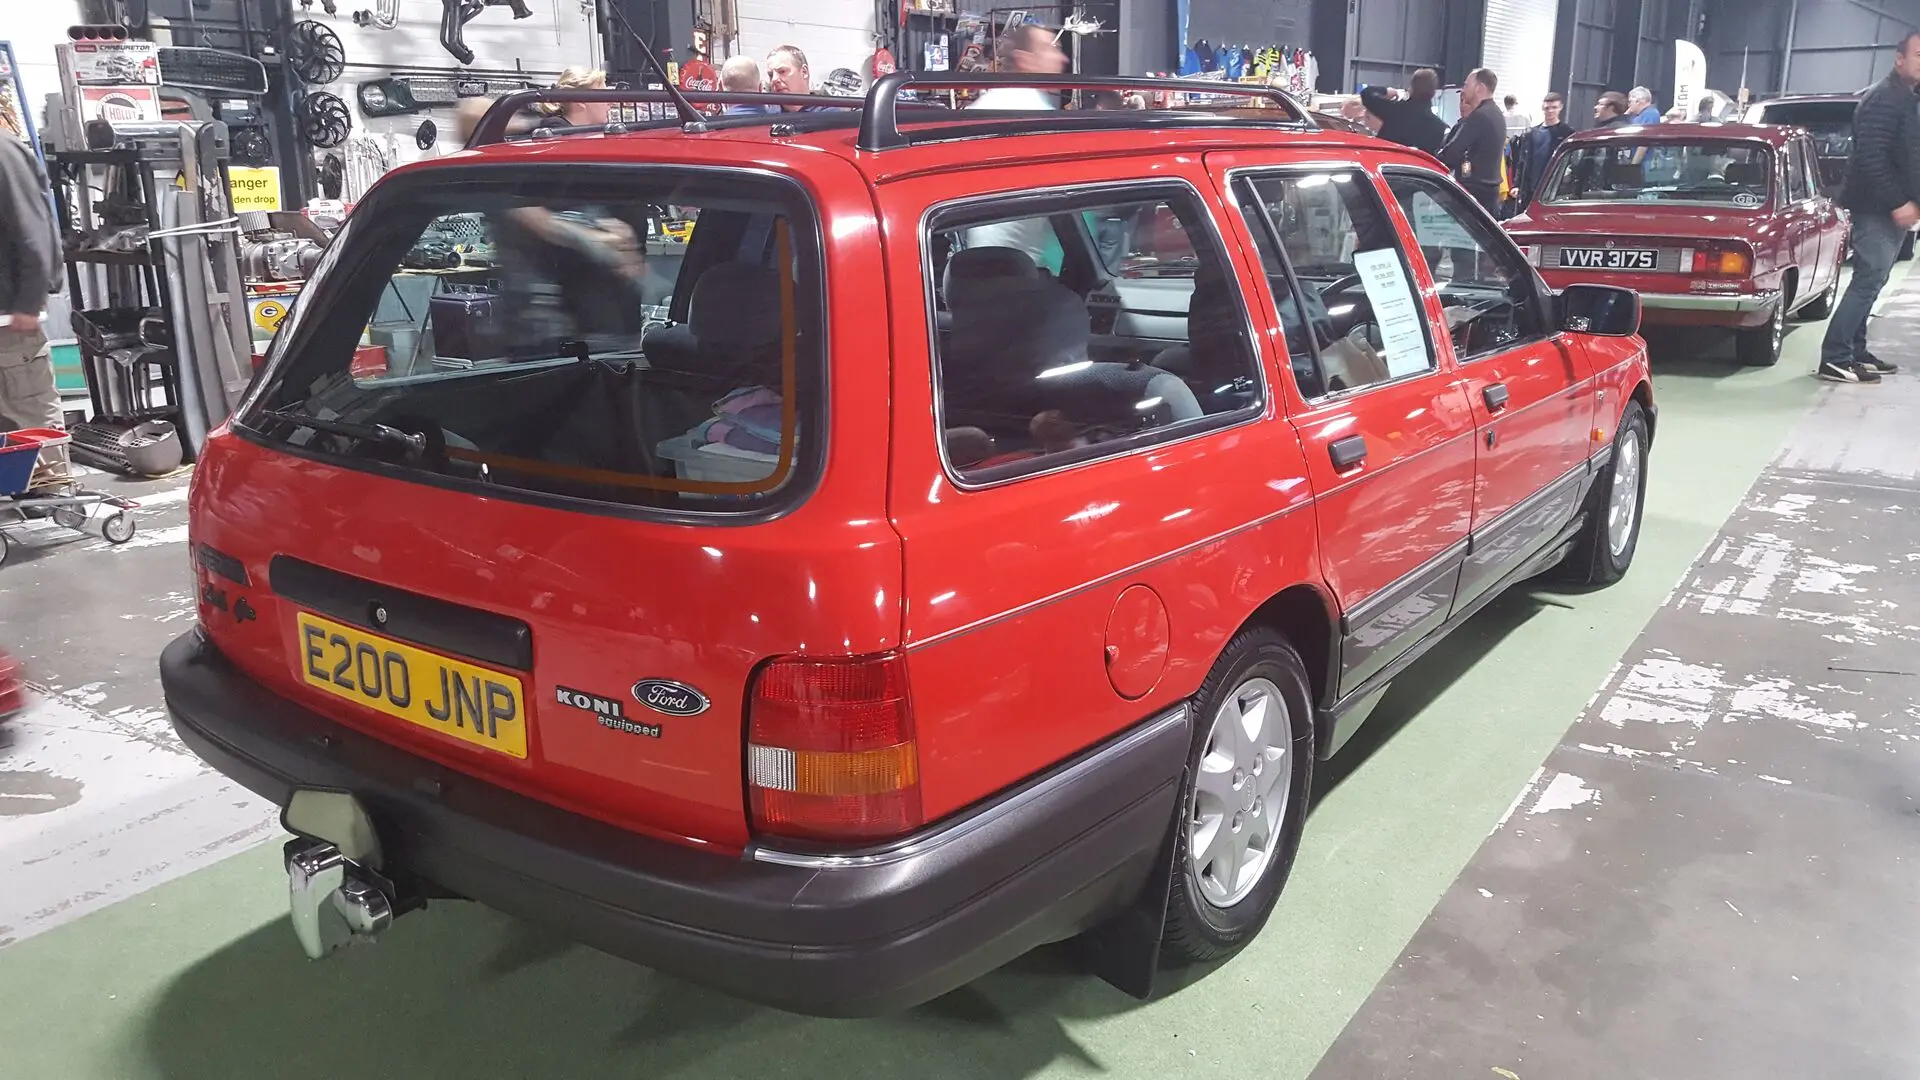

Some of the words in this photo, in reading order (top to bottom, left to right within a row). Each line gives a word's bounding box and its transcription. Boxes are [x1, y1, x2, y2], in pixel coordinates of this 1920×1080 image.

[230, 179, 268, 190] anger
[254, 196, 276, 204] drop
[1566, 250, 1604, 267] VVR
[1607, 251, 1652, 268] 317S
[303, 622, 411, 708] E200
[424, 666, 516, 739] JNP
[556, 689, 620, 717] KONI
[648, 684, 688, 709] Ford
[597, 715, 659, 737] equipped
